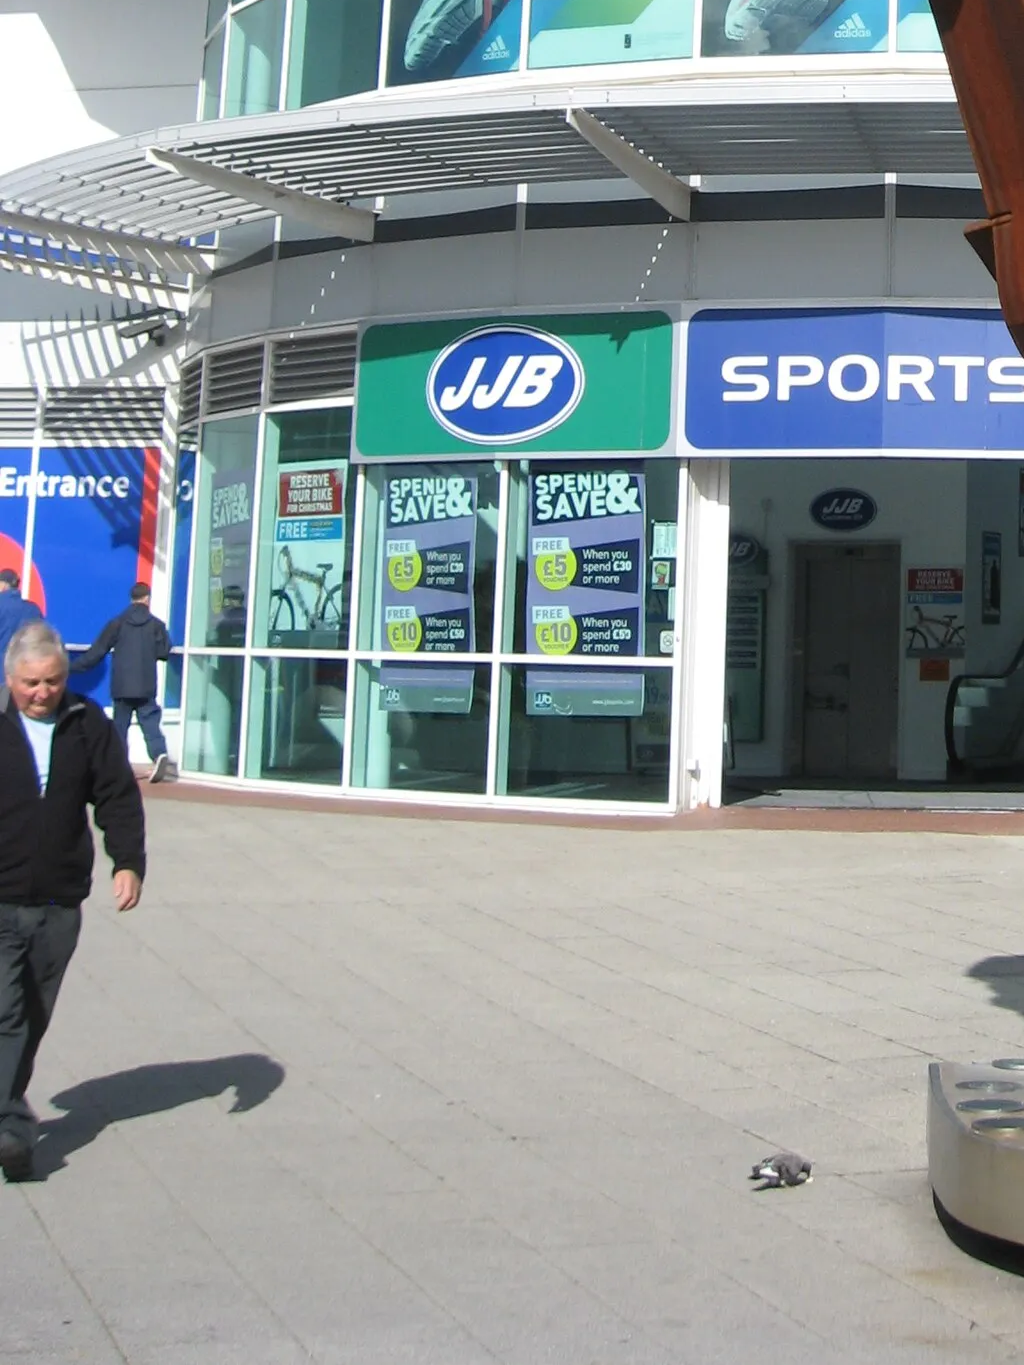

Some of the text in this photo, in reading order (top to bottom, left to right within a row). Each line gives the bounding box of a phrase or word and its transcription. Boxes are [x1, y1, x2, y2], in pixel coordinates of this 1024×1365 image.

[834, 28, 872, 39] adidas
[482, 47, 510, 61] adidas
[439, 354, 564, 411] JJB
[0, 466, 130, 498] Entrance
[290, 473, 330, 488] RESERVE
[288, 487, 333, 502] YOUR BIKE
[390, 475, 473, 518] SPEND &
[535, 470, 642, 514] SPEND &
[299, 502, 333, 513] CHRISTMAS
[390, 494, 446, 523] SAVE
[536, 491, 607, 521] SAVE
[822, 498, 864, 513] JJB
[279, 521, 309, 540] FREE
[388, 541, 412, 553] FREE
[535, 539, 563, 551] FREE
[582, 548, 628, 562] When you
[543, 554, 568, 577] £5
[582, 561, 611, 574] spend
[582, 574, 620, 584] or more
[387, 608, 411, 619] FREE
[535, 608, 563, 620] FREE
[581, 616, 628, 629] When you
[540, 622, 572, 642] £10
[582, 629, 611, 642] spend
[582, 642, 620, 652] or more
